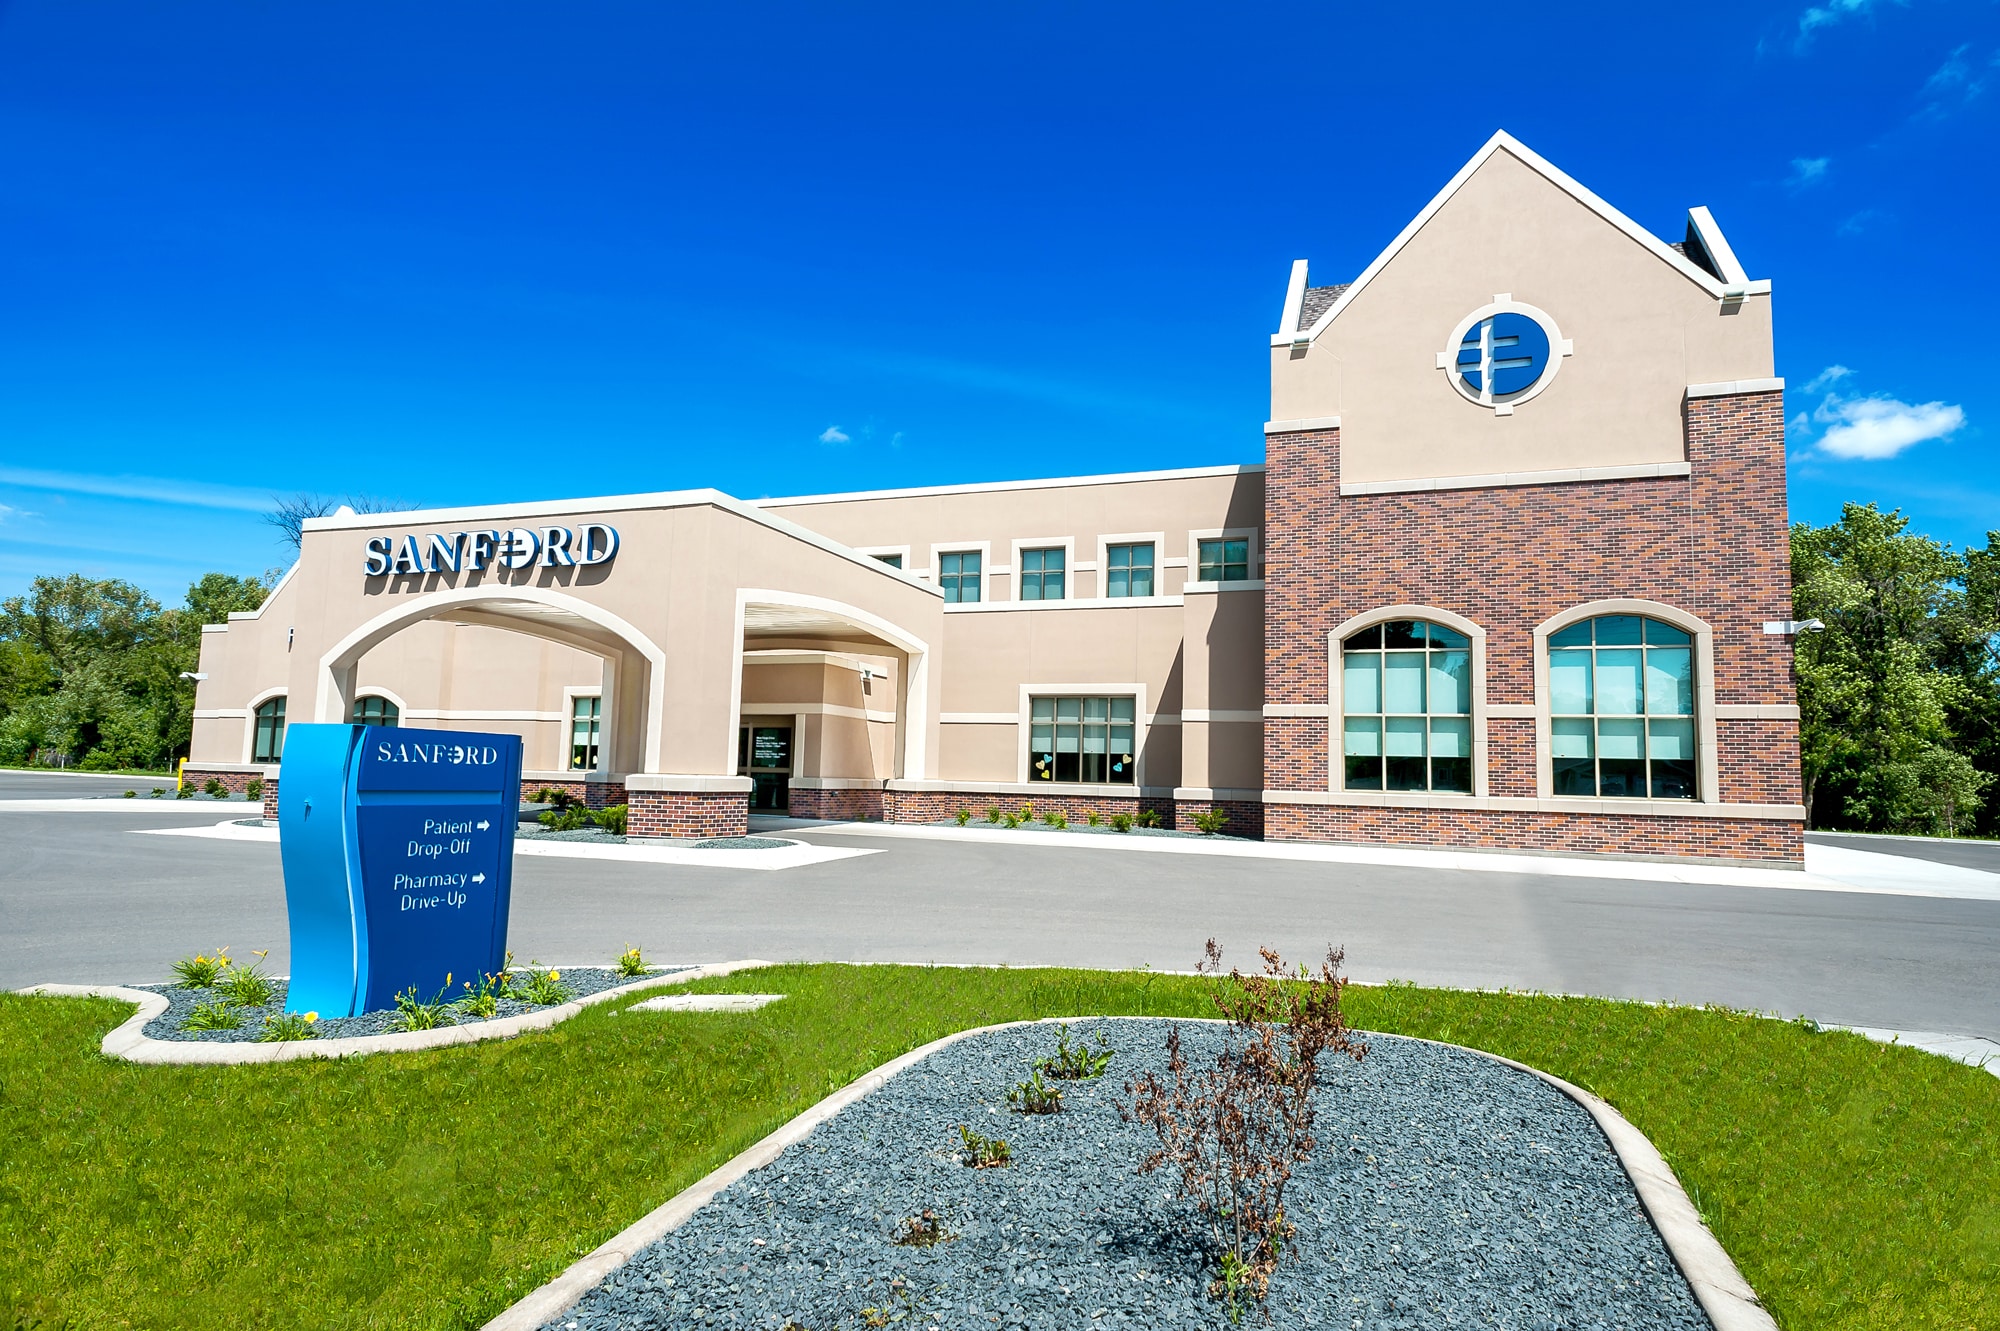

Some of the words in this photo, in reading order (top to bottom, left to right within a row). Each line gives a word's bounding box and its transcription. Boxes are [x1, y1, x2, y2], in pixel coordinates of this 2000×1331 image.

[364, 523, 620, 576] SANFORD
[377, 741, 498, 765] SANFORD
[424, 819, 473, 835] Patient
[407, 838, 471, 860] Drop-Off
[393, 872, 467, 890] Pharmacy
[401, 890, 467, 911] Drive-Up
